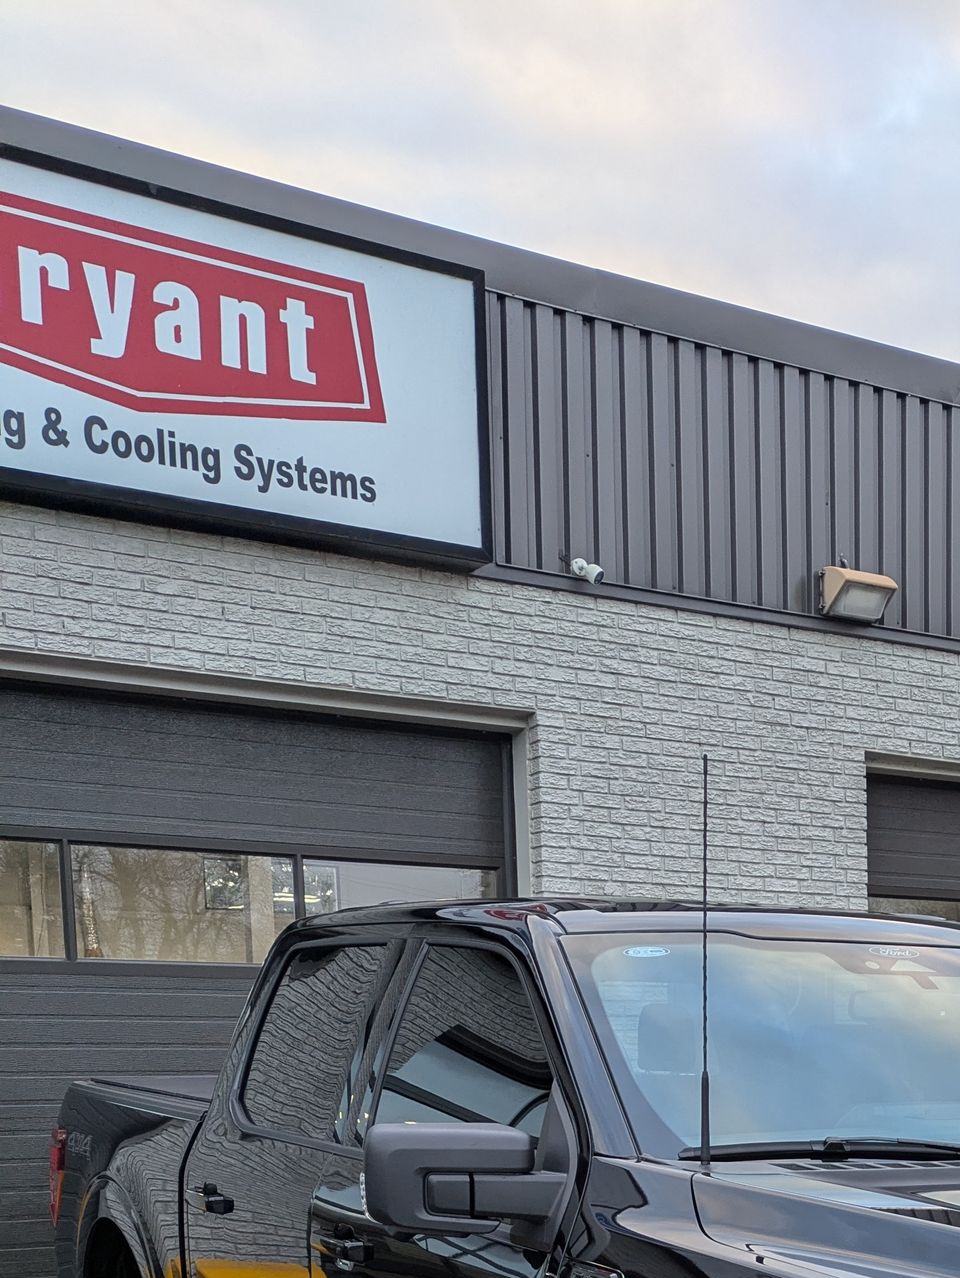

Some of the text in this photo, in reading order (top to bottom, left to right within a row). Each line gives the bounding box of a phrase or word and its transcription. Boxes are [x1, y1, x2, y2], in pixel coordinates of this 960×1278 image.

[17, 245, 317, 386] ryant
[0, 406, 377, 503] g & Cooling Systems
